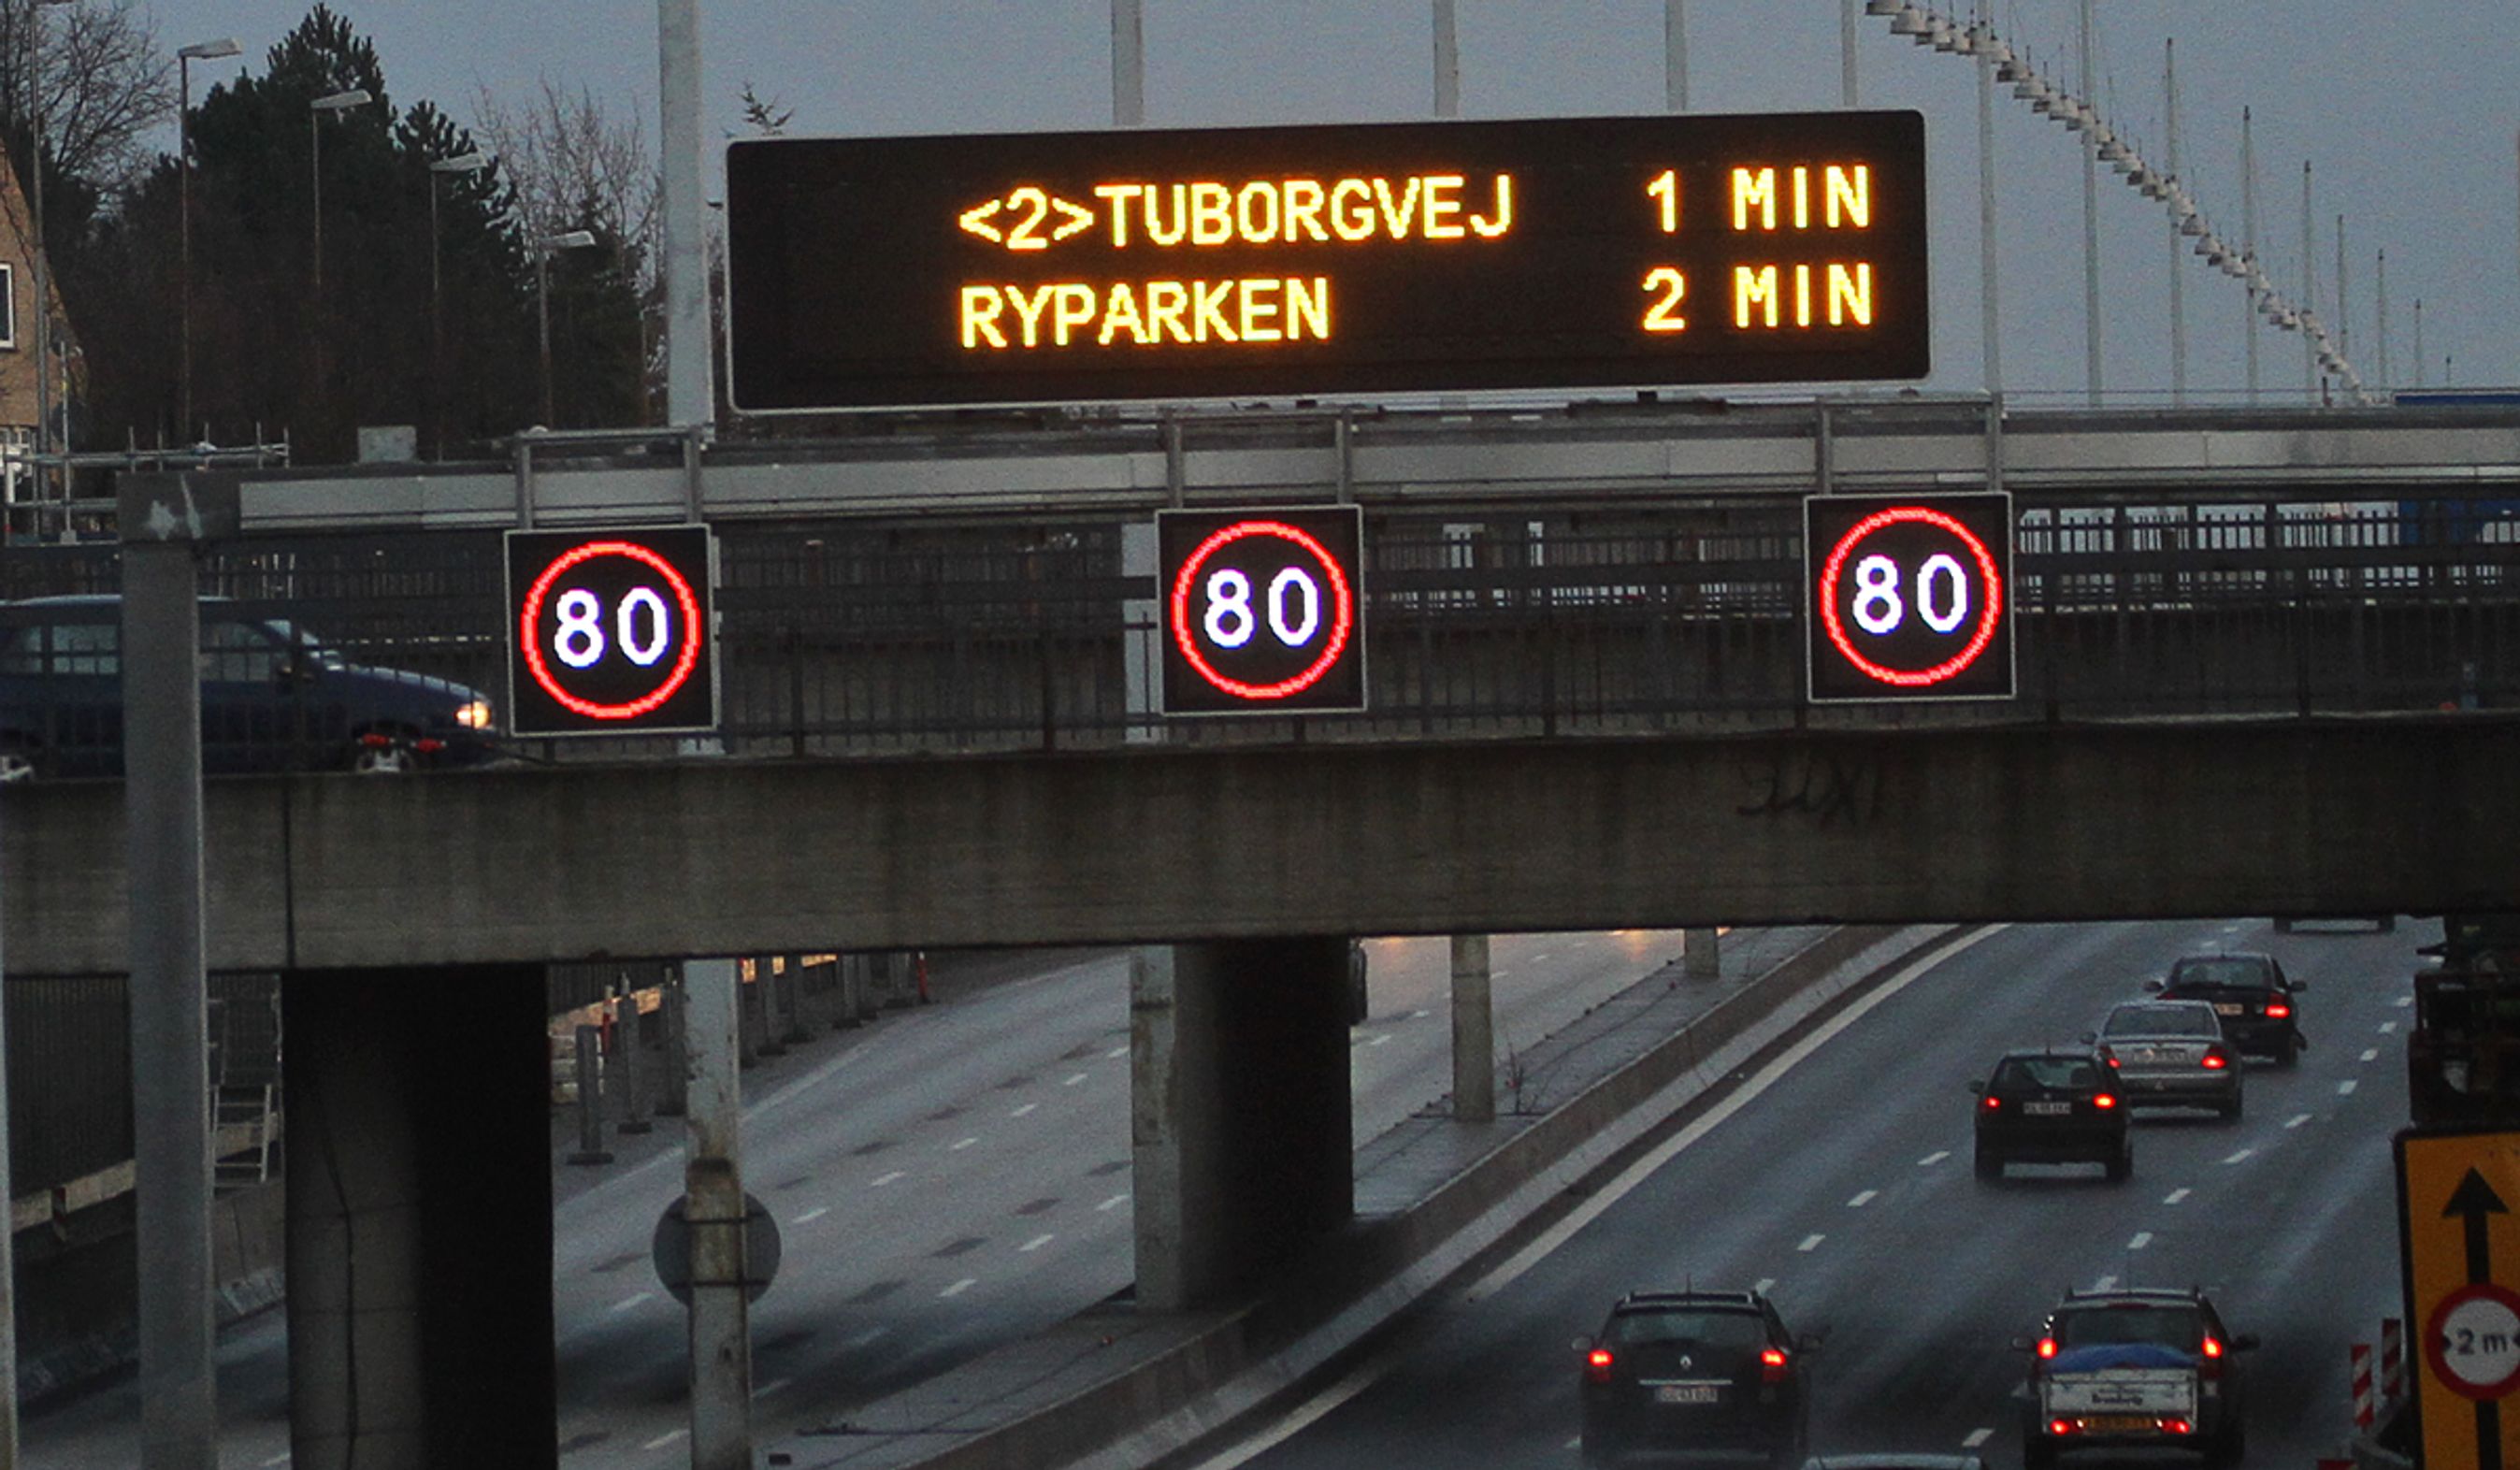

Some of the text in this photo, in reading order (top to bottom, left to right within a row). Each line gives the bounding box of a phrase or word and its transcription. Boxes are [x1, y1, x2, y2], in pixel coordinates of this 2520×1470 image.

[1646, 169, 1677, 233] 1
[1731, 164, 1870, 231] MIN
[959, 263, 1873, 348] RYPARKEN 2 MIN
[553, 587, 669, 668] 80
[1204, 568, 1320, 648] 80
[1853, 554, 1967, 634] 80
[2456, 1327, 2508, 1356] 2 m
